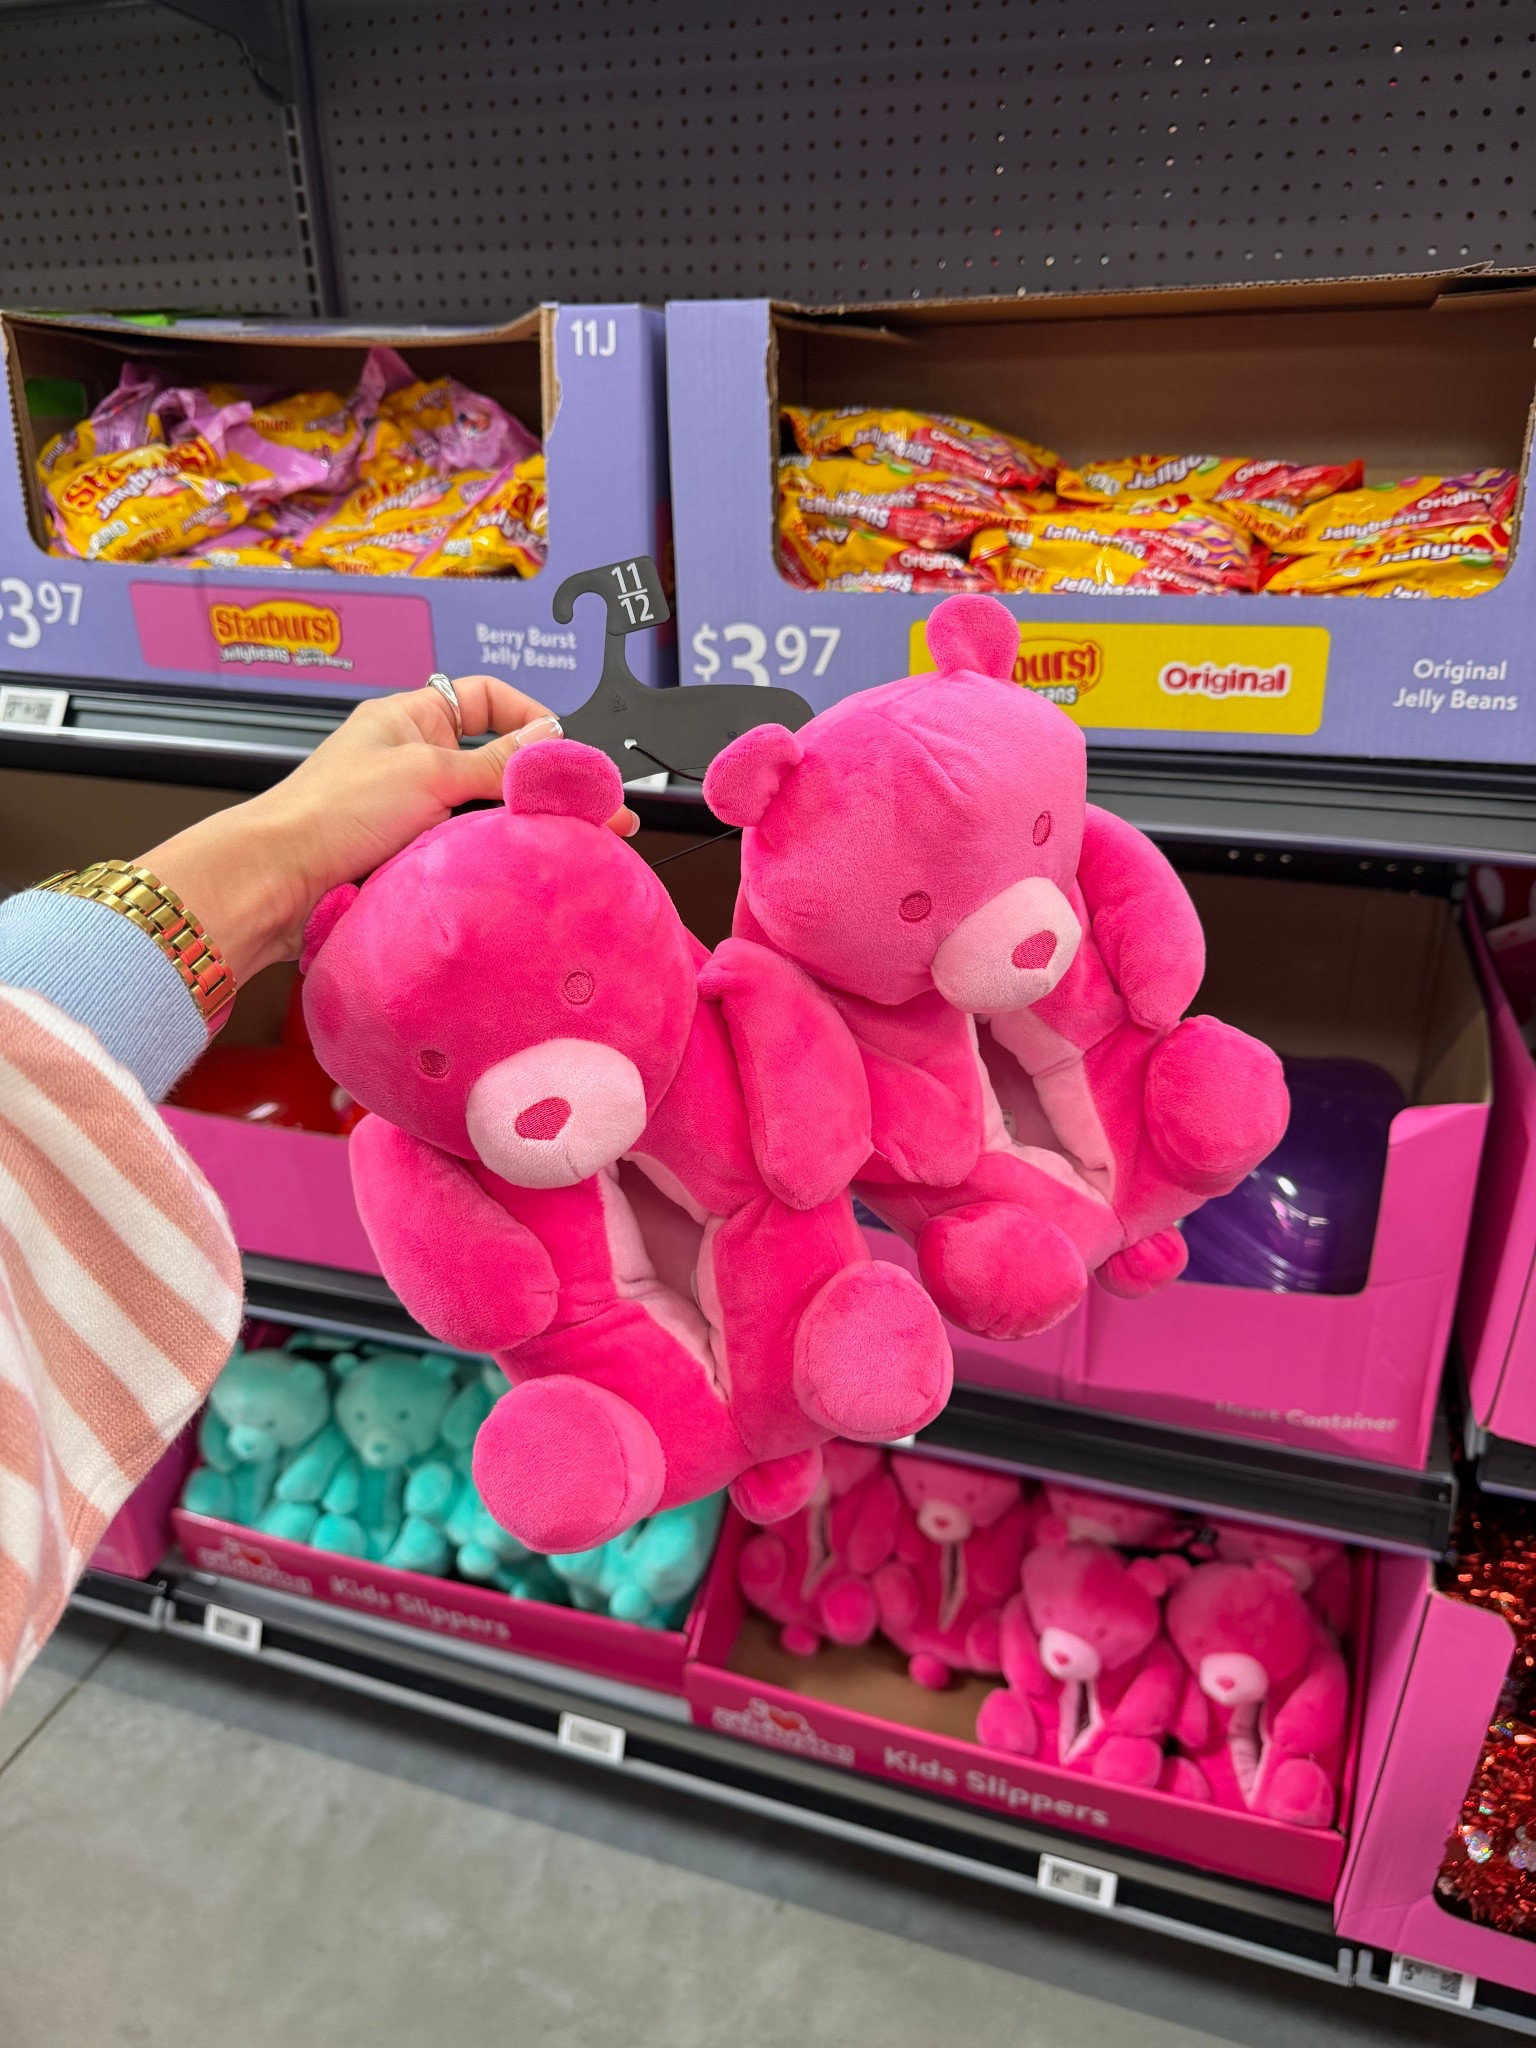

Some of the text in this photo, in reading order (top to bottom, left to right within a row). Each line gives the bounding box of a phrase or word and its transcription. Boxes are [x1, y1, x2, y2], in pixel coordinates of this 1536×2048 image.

[570, 318, 616, 357] 11J
[1319, 512, 1430, 541] Jellybeans
[611, 562, 643, 593] 11
[620, 594, 655, 625] 12
[215, 609, 337, 645] Starburst
[476, 623, 577, 650] Berry Burst
[480, 647, 577, 671] Jelly Beans
[1413, 658, 1508, 684] Original
[1163, 665, 1287, 695] Original
[1392, 687, 1518, 714] Jelly Beans
[1285, 1408, 1397, 1434] Container
[329, 1574, 512, 1642] Kids Slippers
[884, 1746, 1110, 1828] Kids Slippers
